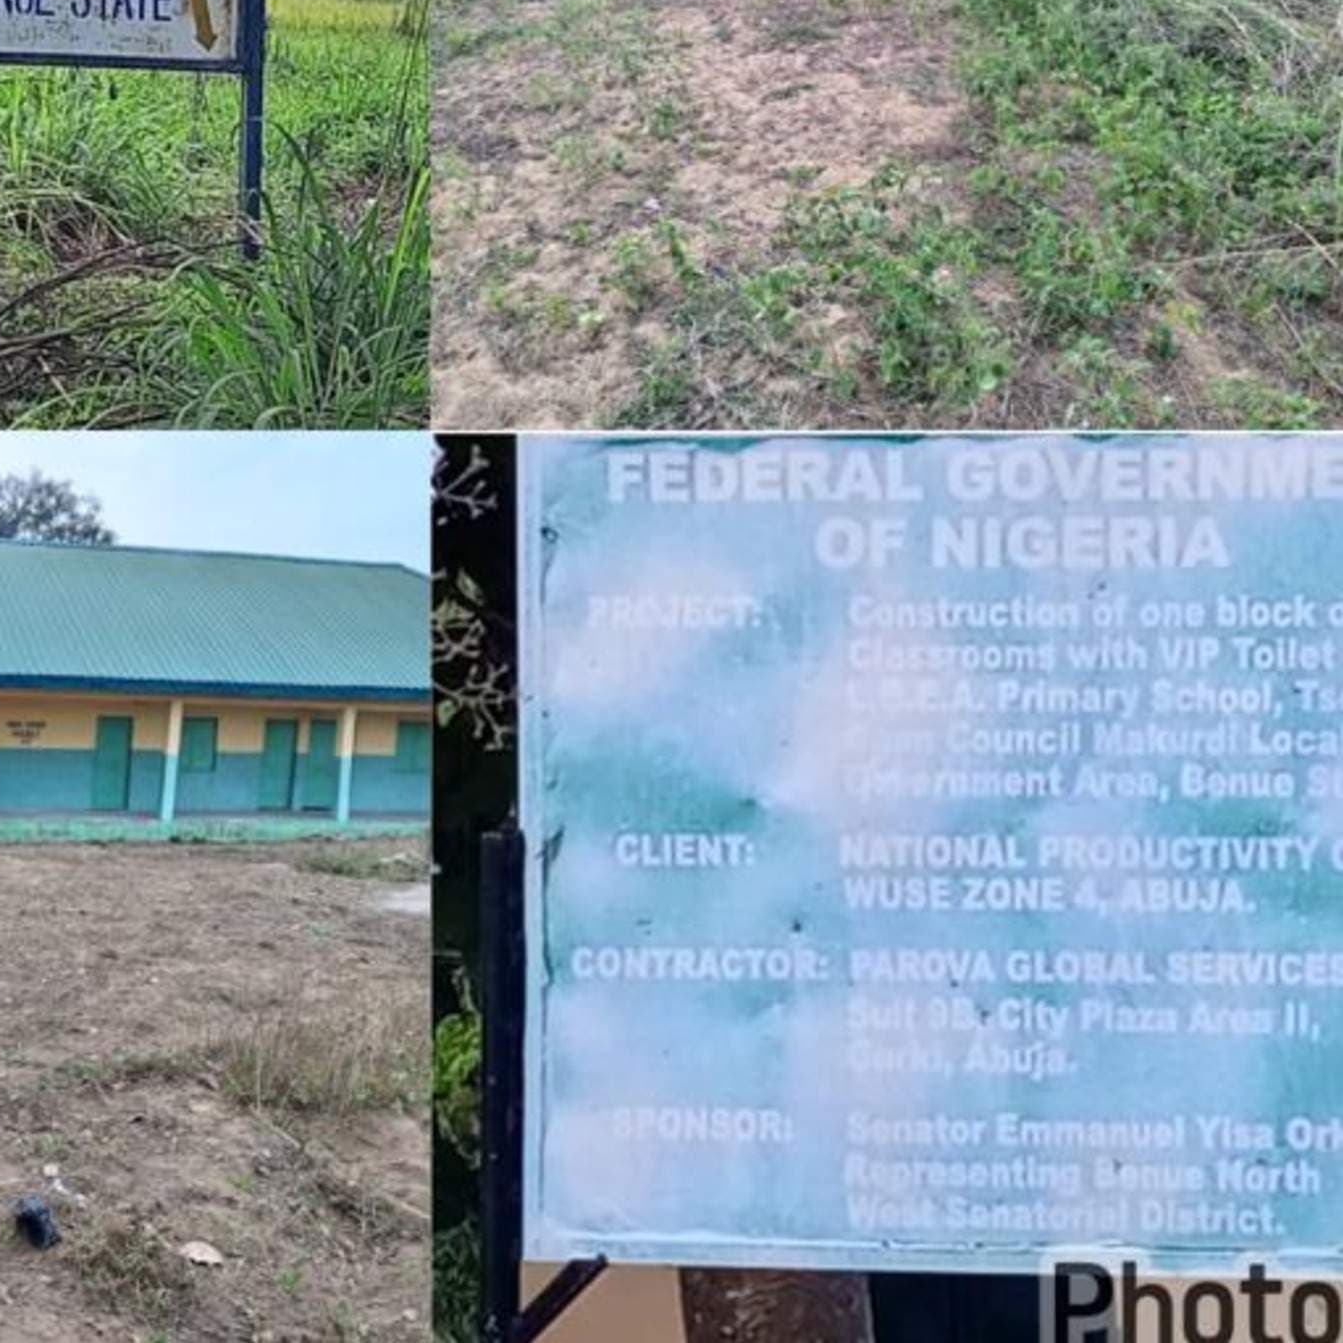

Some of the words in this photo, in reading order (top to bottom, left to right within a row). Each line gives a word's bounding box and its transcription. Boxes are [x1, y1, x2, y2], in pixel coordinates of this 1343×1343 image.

[607, 449, 922, 503] FEDERAL
[947, 447, 1343, 502] GOVERNME
[817, 518, 907, 568] OF
[931, 517, 1229, 568] NIGERIA
[849, 595, 1073, 627] Construction
[1092, 594, 1128, 627] of
[1139, 601, 1206, 627] one
[1217, 594, 1316, 627] block
[850, 636, 1056, 670] Classrooms
[1067, 636, 1148, 669] with
[1157, 636, 1220, 669] VIP
[1231, 636, 1338, 670] Toilet
[997, 678, 1140, 720] Primary
[1151, 678, 1284, 719] School,
[945, 722, 1080, 755] Council
[1093, 722, 1239, 755] Makurdi
[1250, 722, 1343, 755] Loca
[1181, 762, 1295, 799] Benue
[616, 834, 755, 867] CLIENT:
[839, 834, 1026, 868] NATIONAL
[1039, 835, 1318, 870] PRODUCTIVITY
[844, 876, 951, 910] WUSE
[961, 876, 1064, 911] ZONE
[1121, 878, 1257, 913] ABUJA.
[572, 947, 829, 981] CONTRACTOR:
[850, 949, 996, 982] PAROVA
[1008, 949, 1155, 984] GLOBAL
[998, 997, 1069, 1040] City
[1080, 999, 1177, 1033] Plaza
[1188, 1001, 1276, 1035] Area
[963, 1041, 1077, 1082] Abuja.
[611, 1107, 794, 1142] SPONSOR:
[847, 1112, 986, 1146] Senator
[996, 1113, 1184, 1148] Emmanuel
[1195, 1115, 1274, 1150] Yisa
[844, 1152, 1081, 1196] Representing
[1094, 1155, 1205, 1190] Benue
[1217, 1158, 1320, 1194] North
[947, 1195, 1128, 1233] Senatorial
[1140, 1199, 1288, 1236] District.
